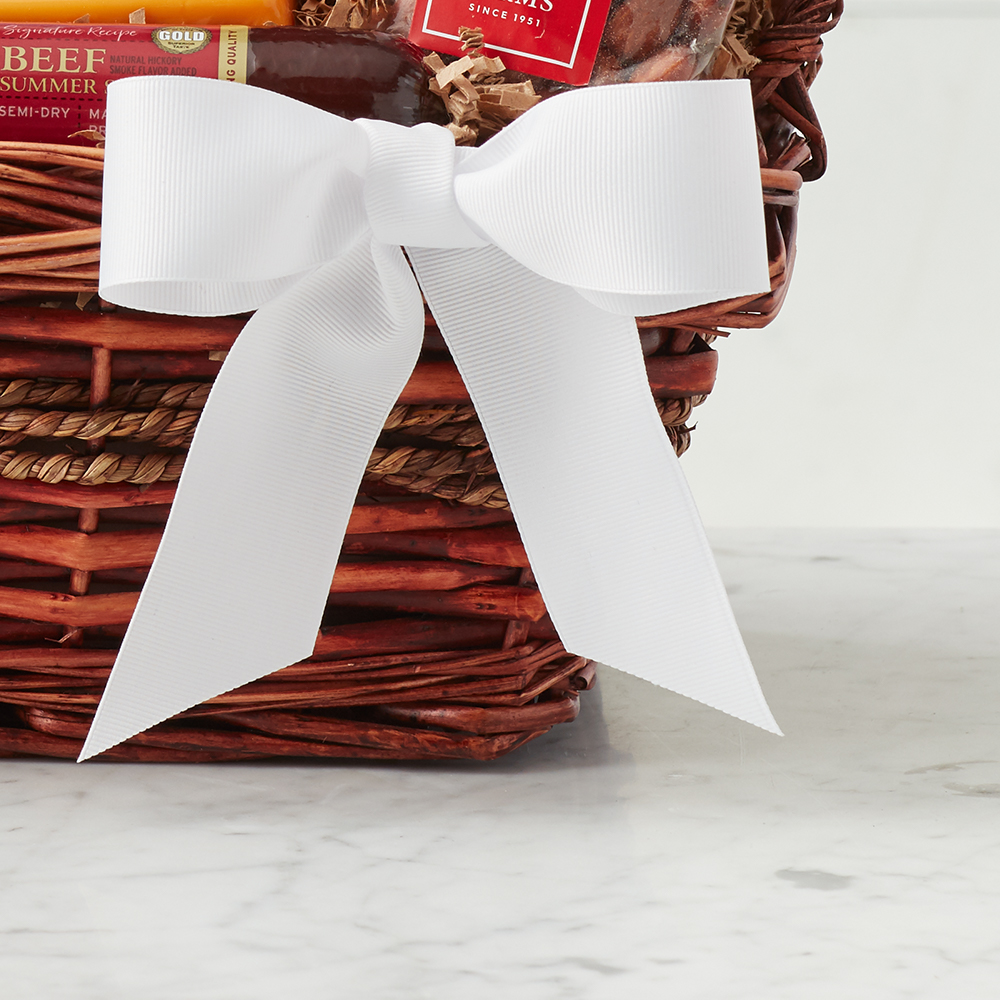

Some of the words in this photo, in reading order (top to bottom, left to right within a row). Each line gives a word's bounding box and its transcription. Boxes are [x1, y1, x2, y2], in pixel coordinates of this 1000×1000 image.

[468, 3, 508, 19] SINCE
[513, 13, 541, 27] 1951
[3, 24, 84, 40] Signature
[87, 26, 137, 41] Recipe
[159, 30, 205, 41] GOLD
[227, 30, 237, 65] QUALITY
[0, 45, 106, 74] BEEF
[109, 55, 145, 65] NATURAL
[148, 56, 182, 65] HICKORY
[109, 65, 136, 75] SMOKE
[138, 66, 169, 75] FLAVOR
[170, 67, 197, 77] ADDED
[0, 76, 97, 95] SUMMER
